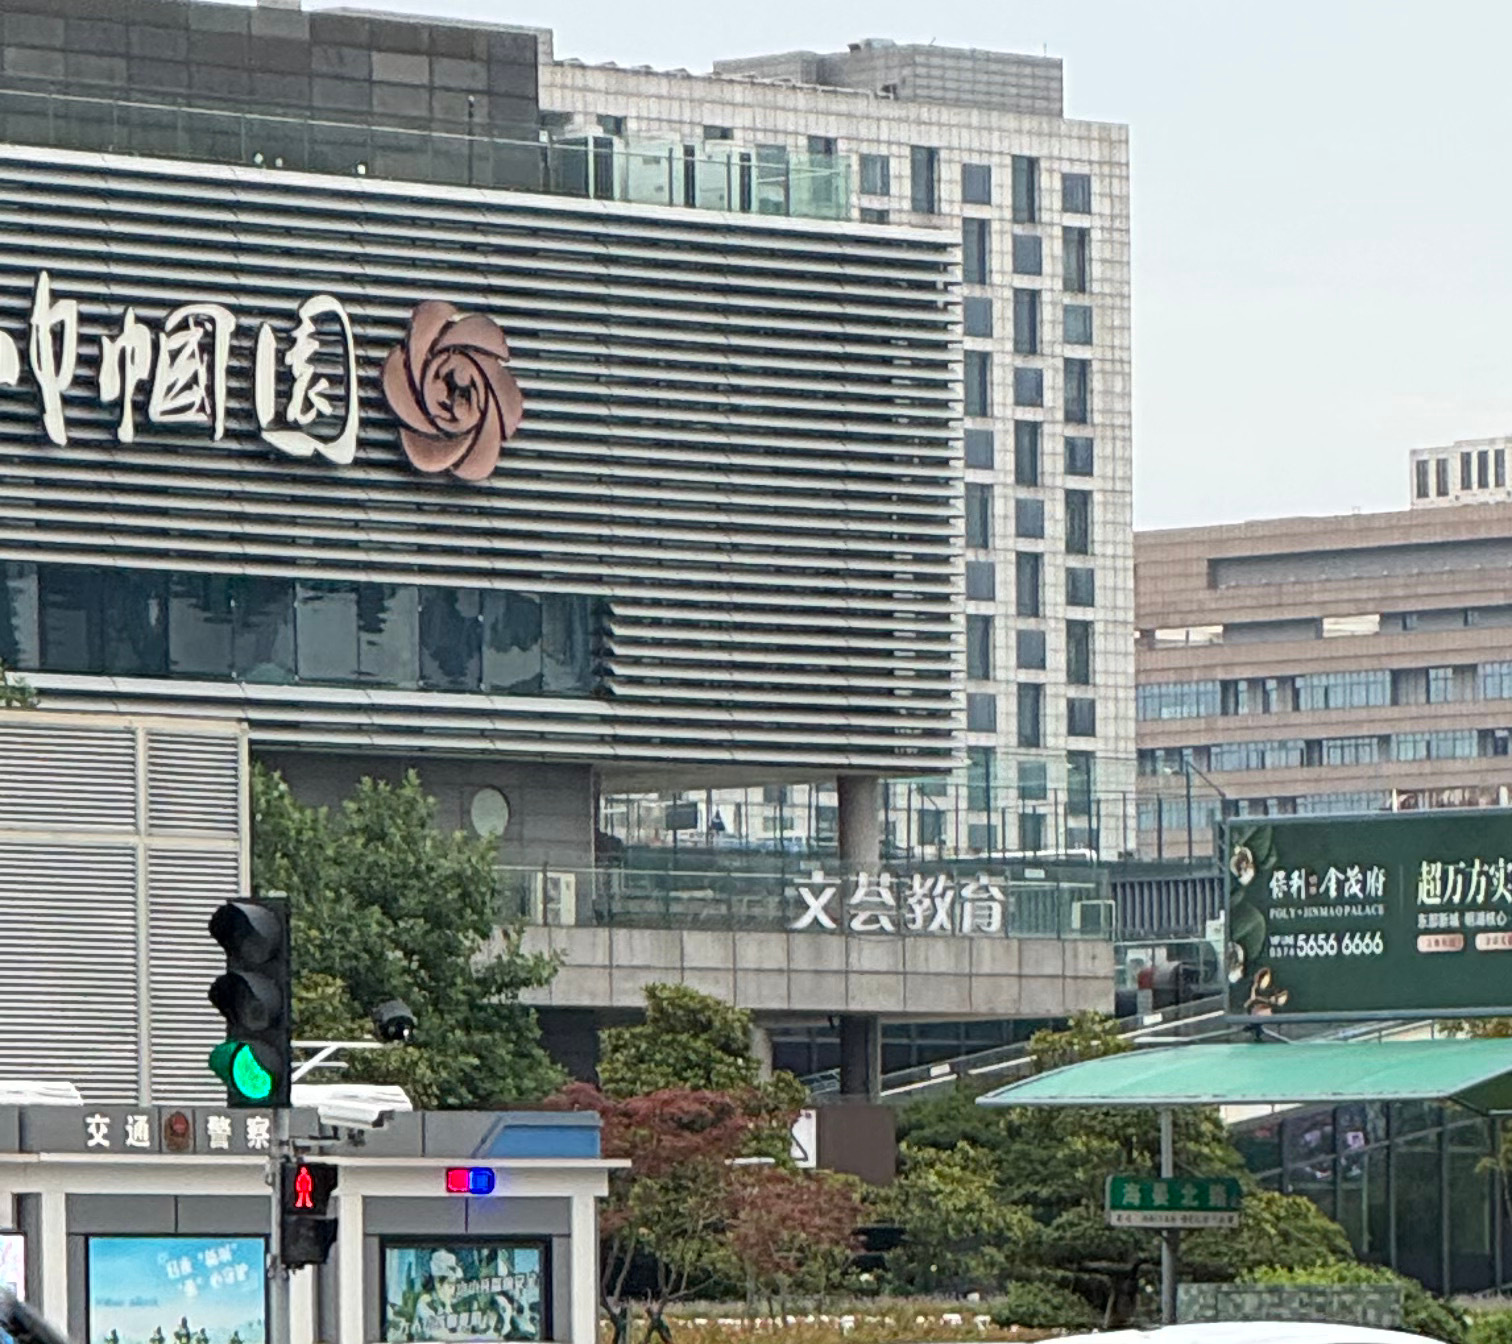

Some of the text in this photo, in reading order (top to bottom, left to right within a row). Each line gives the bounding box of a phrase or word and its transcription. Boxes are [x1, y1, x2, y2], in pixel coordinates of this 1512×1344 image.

[787, 869, 1006, 934] 文荟教育
[1296, 933, 1338, 957] 5656
[1341, 931, 1384, 955] 6666
[85, 1113, 271, 1150] 交通 警察
